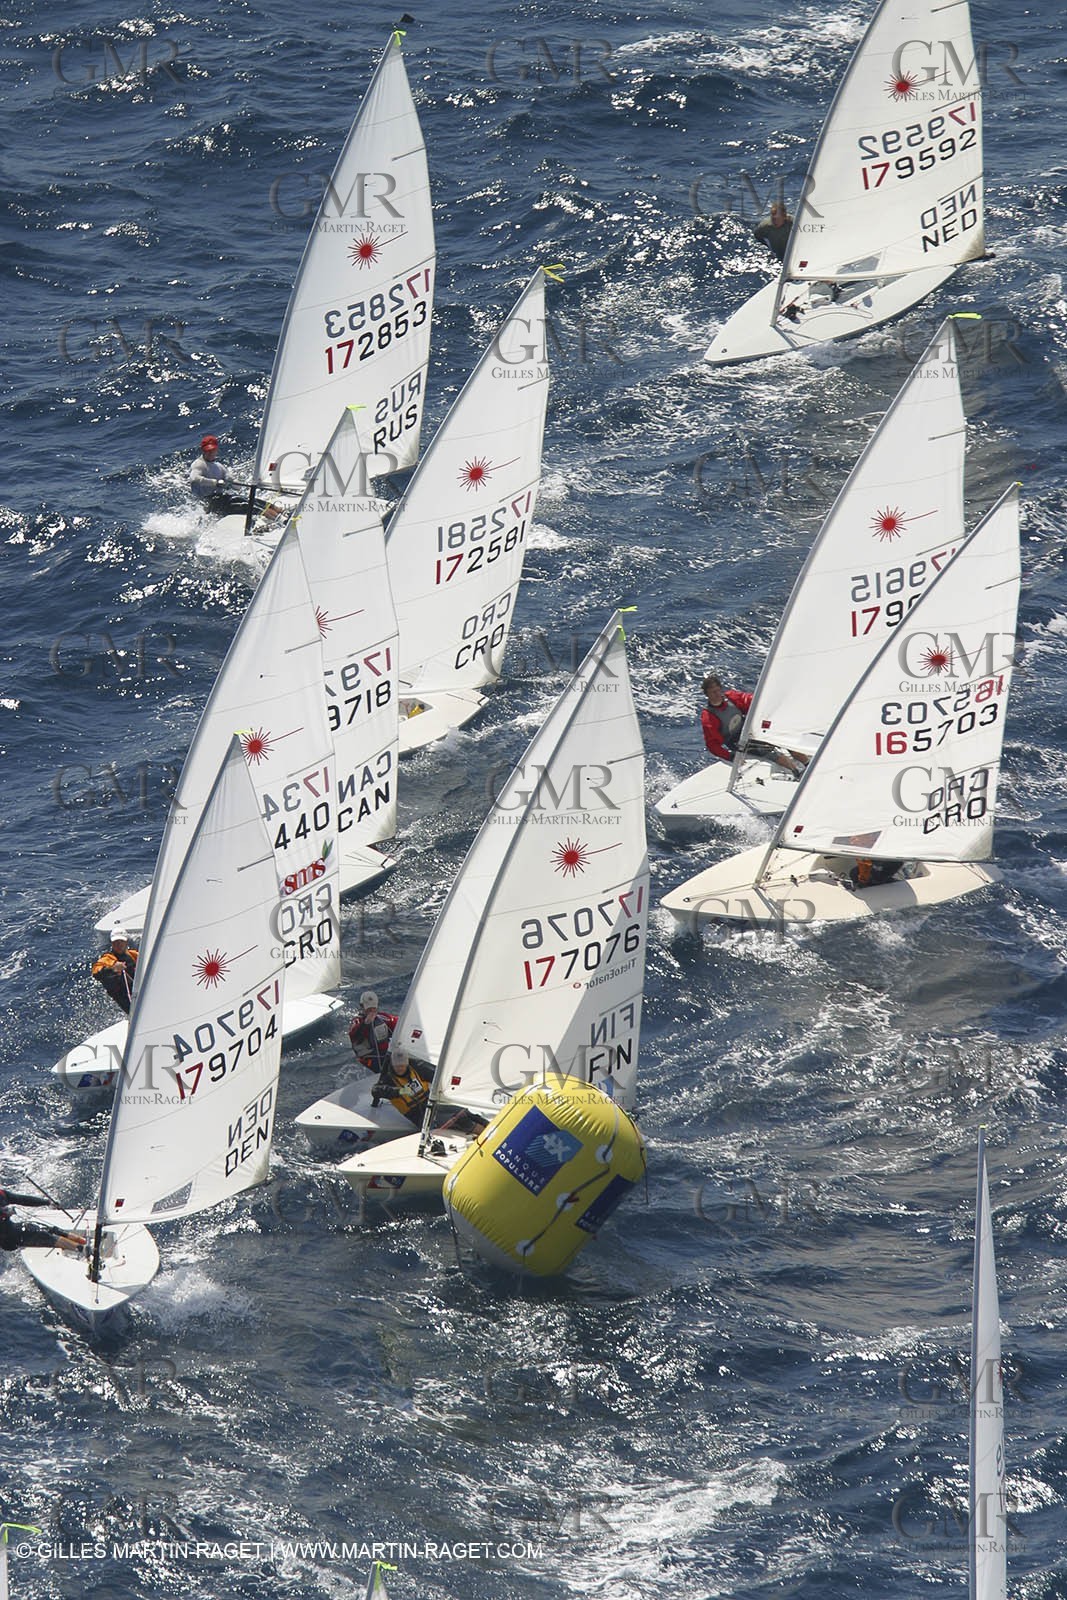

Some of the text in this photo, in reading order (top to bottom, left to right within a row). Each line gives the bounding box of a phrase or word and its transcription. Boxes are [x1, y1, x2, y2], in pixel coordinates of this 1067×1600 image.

[862, 128, 976, 190] 179592
[922, 208, 977, 252] NED
[325, 300, 426, 374] 172853
[374, 404, 417, 454] RUS
[436, 520, 526, 584] 172581
[454, 623, 505, 670] CRO
[876, 703, 998, 756] 165703
[274, 802, 330, 850] 440
[338, 781, 390, 832] CAN
[923, 796, 986, 834] CRO
[284, 918, 332, 968] CRO
[524, 924, 640, 990] 177076
[176, 1014, 278, 1100] 179704
[588, 1038, 632, 1083] FIN
[226, 1118, 269, 1178] DEN
[496, 1149, 540, 1192] POPULAIRE
